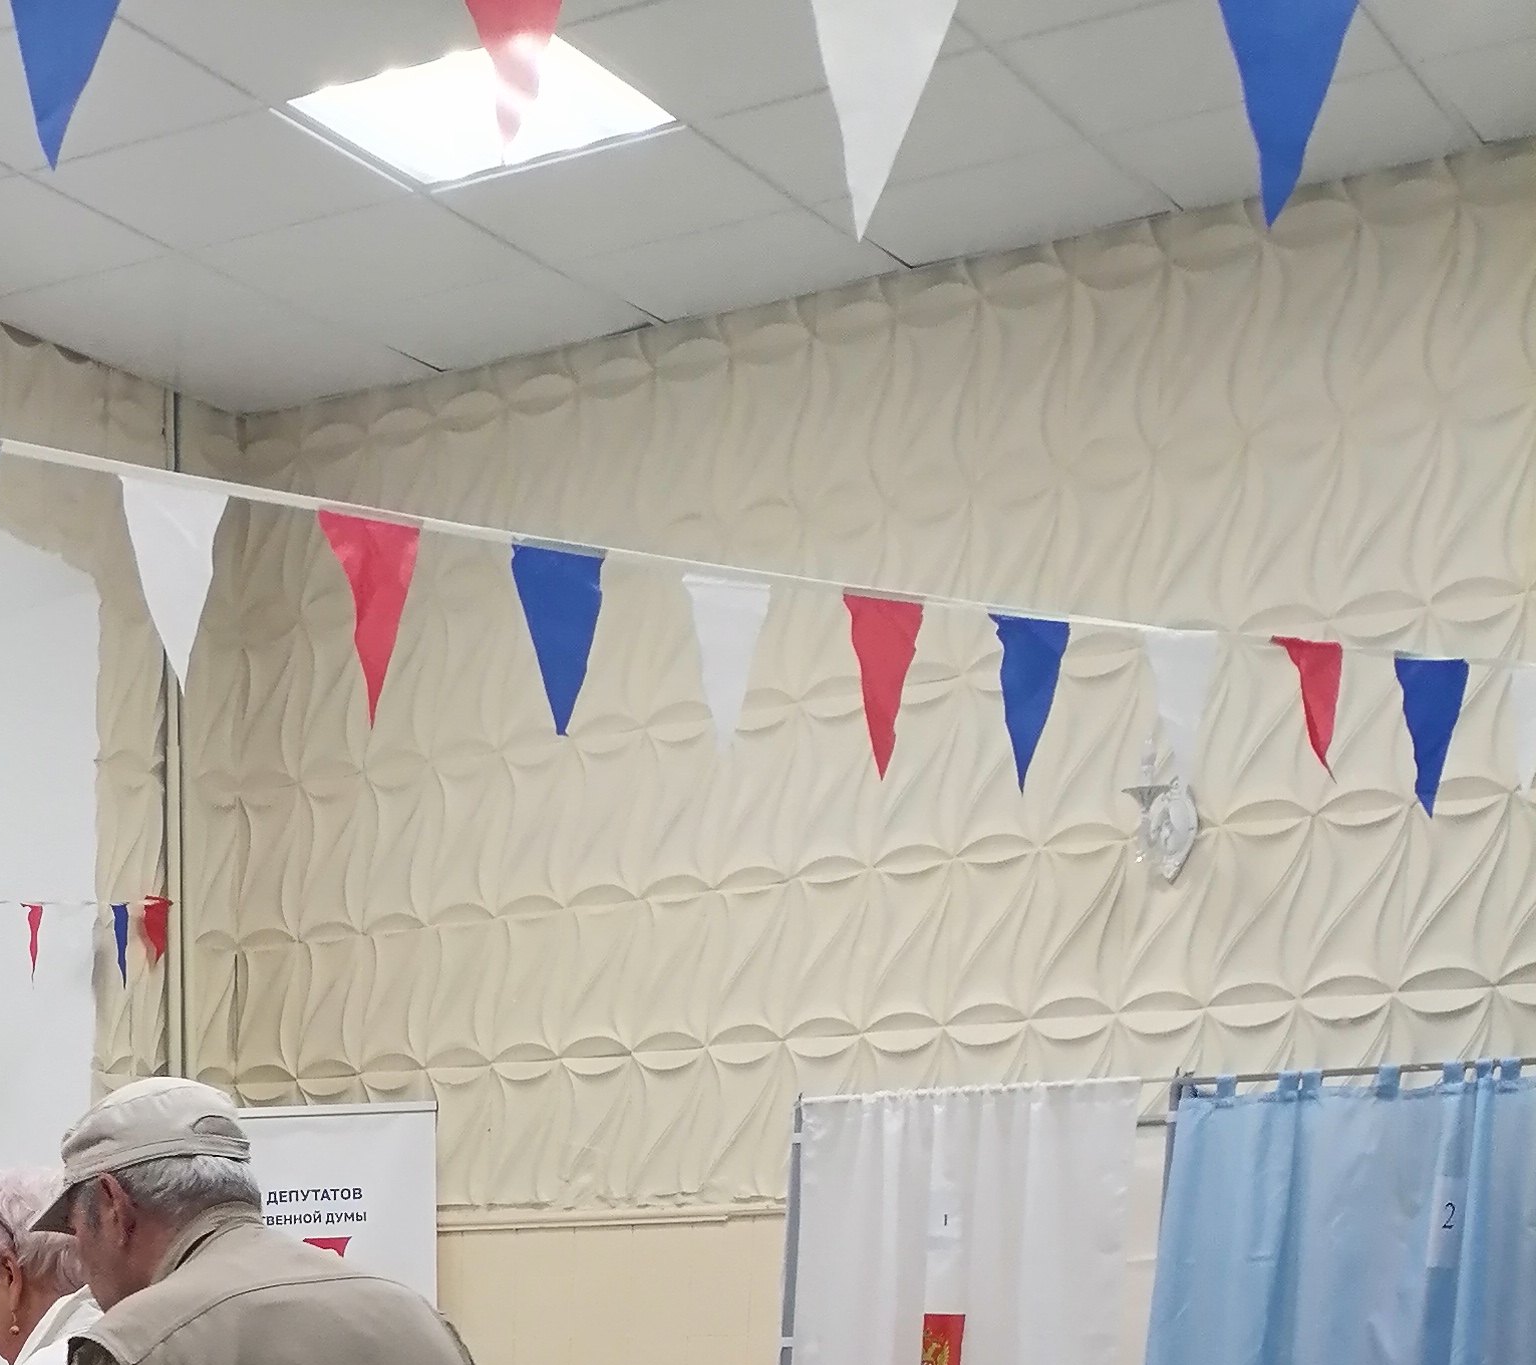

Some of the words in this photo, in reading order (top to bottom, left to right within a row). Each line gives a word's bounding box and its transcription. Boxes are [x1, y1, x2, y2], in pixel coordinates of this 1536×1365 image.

[266, 1187, 363, 1206] ДЕПУТАТОВ
[262, 1210, 322, 1226] ВЕННОЙ
[325, 1211, 367, 1225] ДУМЫ
[1442, 1202, 1456, 1229] 2
